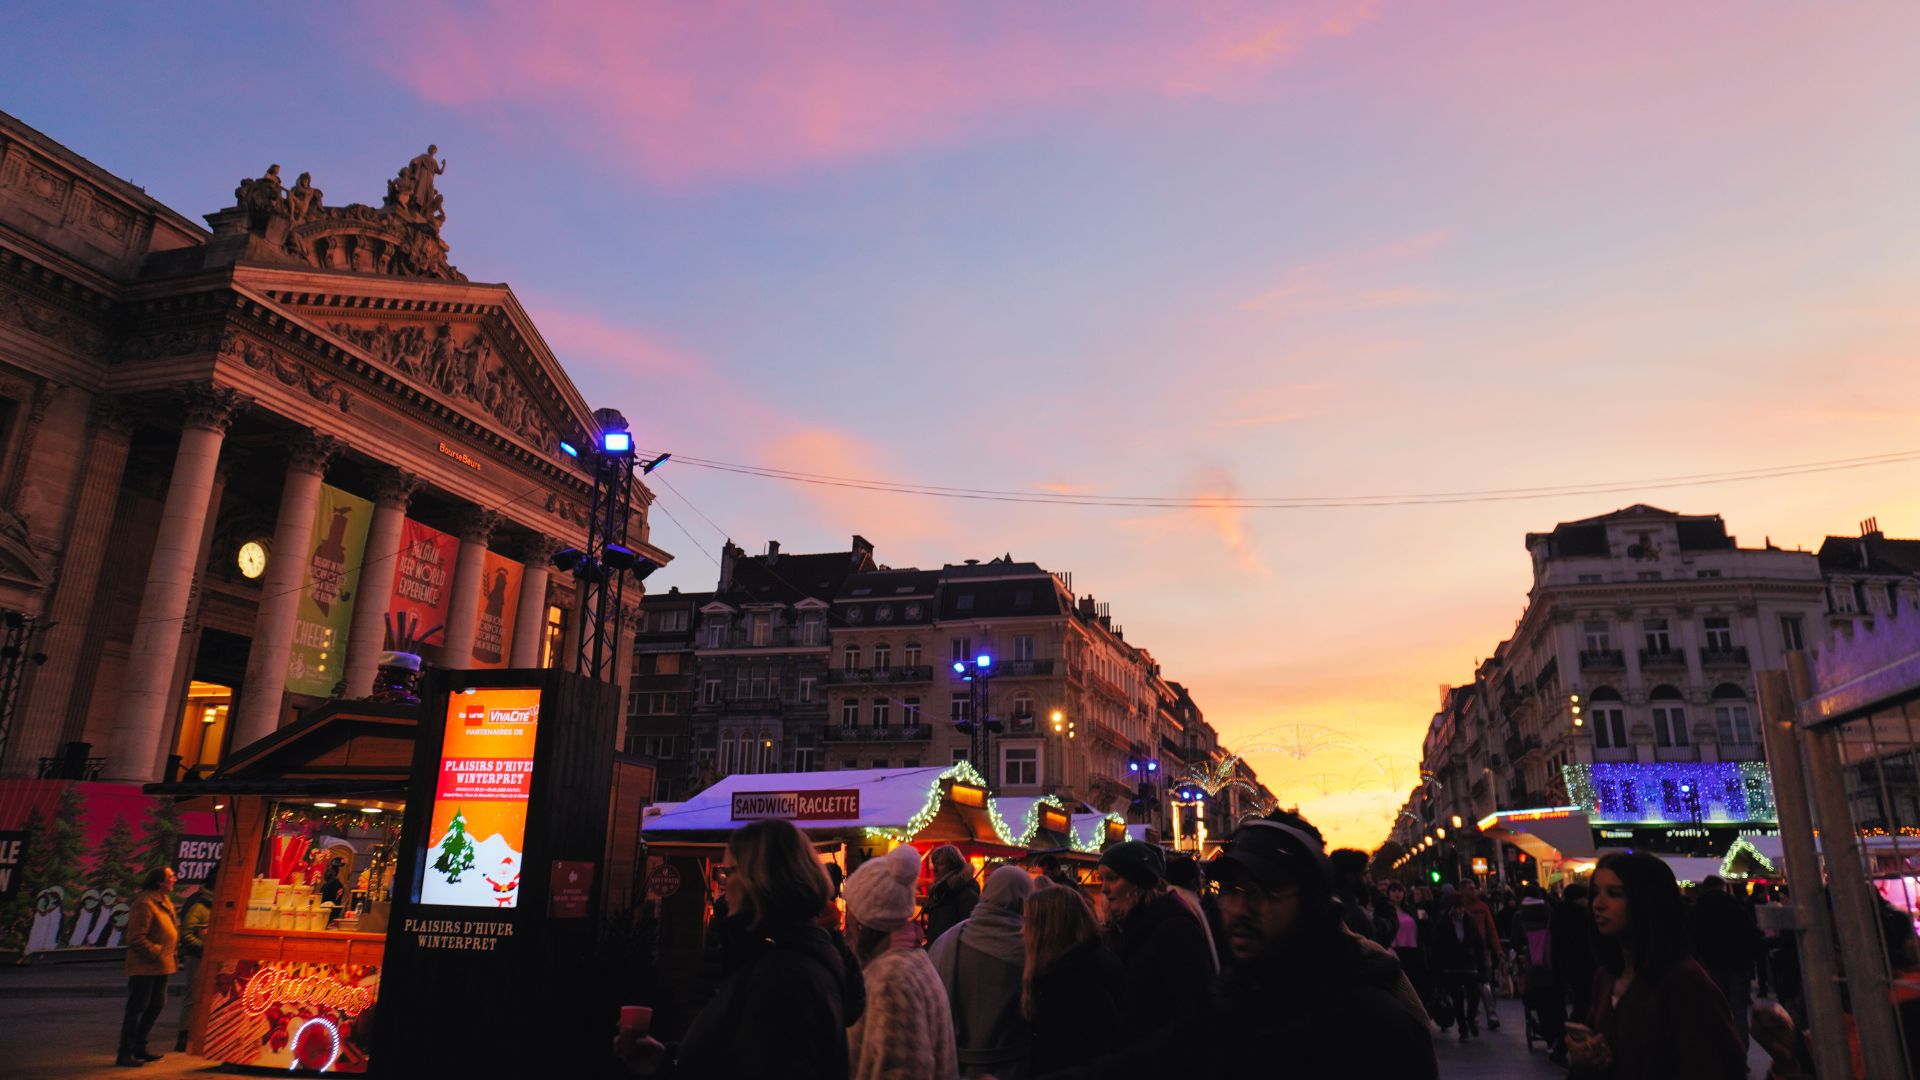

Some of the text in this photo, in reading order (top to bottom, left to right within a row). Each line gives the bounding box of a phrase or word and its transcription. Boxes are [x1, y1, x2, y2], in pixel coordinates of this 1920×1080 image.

[415, 561, 445, 586] WORLD
[398, 579, 439, 606] EXPERIENCE
[465, 728, 513, 736] PARTENAIRES
[445, 760, 494, 772] PLAISIRS
[456, 773, 524, 785] WINTERPRET
[735, 796, 857, 815] SANDWICH RACLETTE
[177, 861, 217, 880] STAT
[403, 919, 514, 936] PLAISIRS D'HIVER
[417, 935, 497, 951] WINTERPRET
